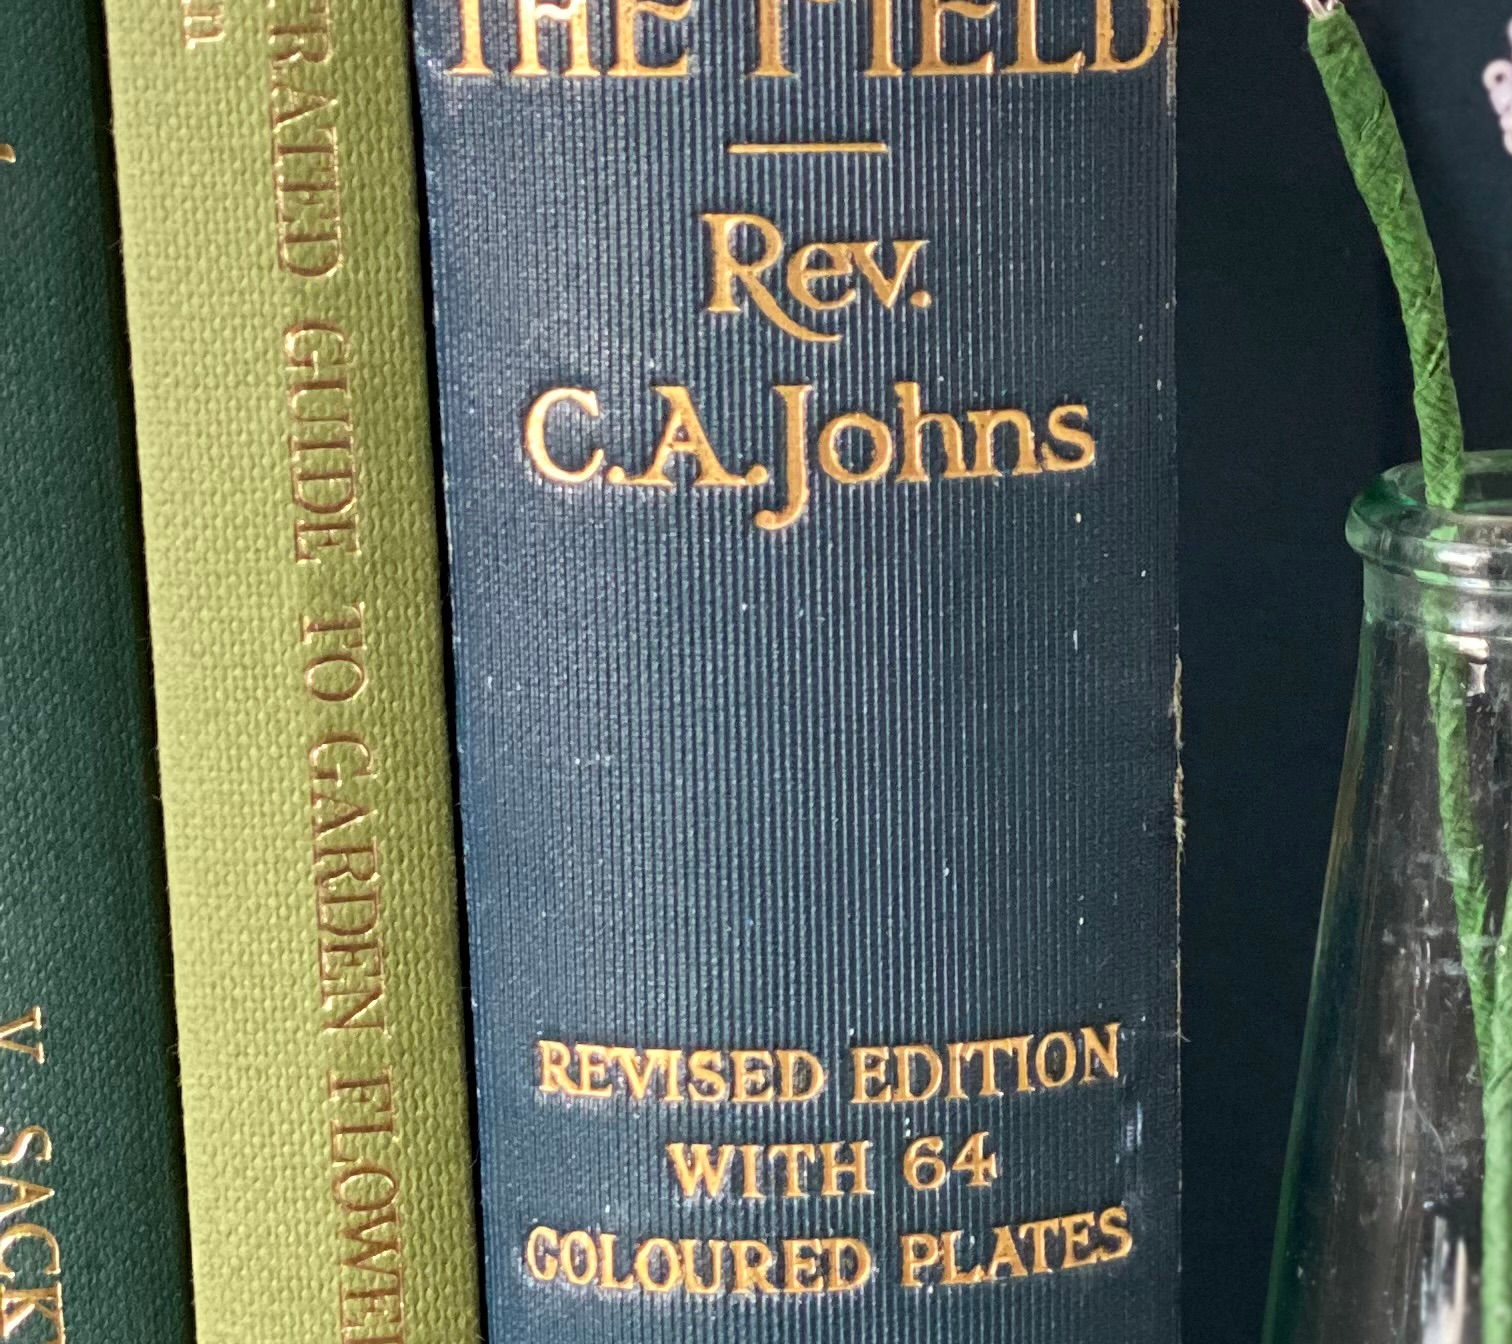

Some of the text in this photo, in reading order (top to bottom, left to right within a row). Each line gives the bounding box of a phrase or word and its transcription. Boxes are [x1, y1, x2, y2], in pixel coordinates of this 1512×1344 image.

[701, 211, 932, 342] Rev.
[282, 318, 362, 565] GUIDE
[299, 601, 368, 704] TO
[307, 732, 390, 1038] GARDEN
[537, 1022, 1122, 1105] REVISED EDITION
[665, 1131, 997, 1199] WITH 64
[525, 1206, 1133, 1295] COLOURED PLATES
